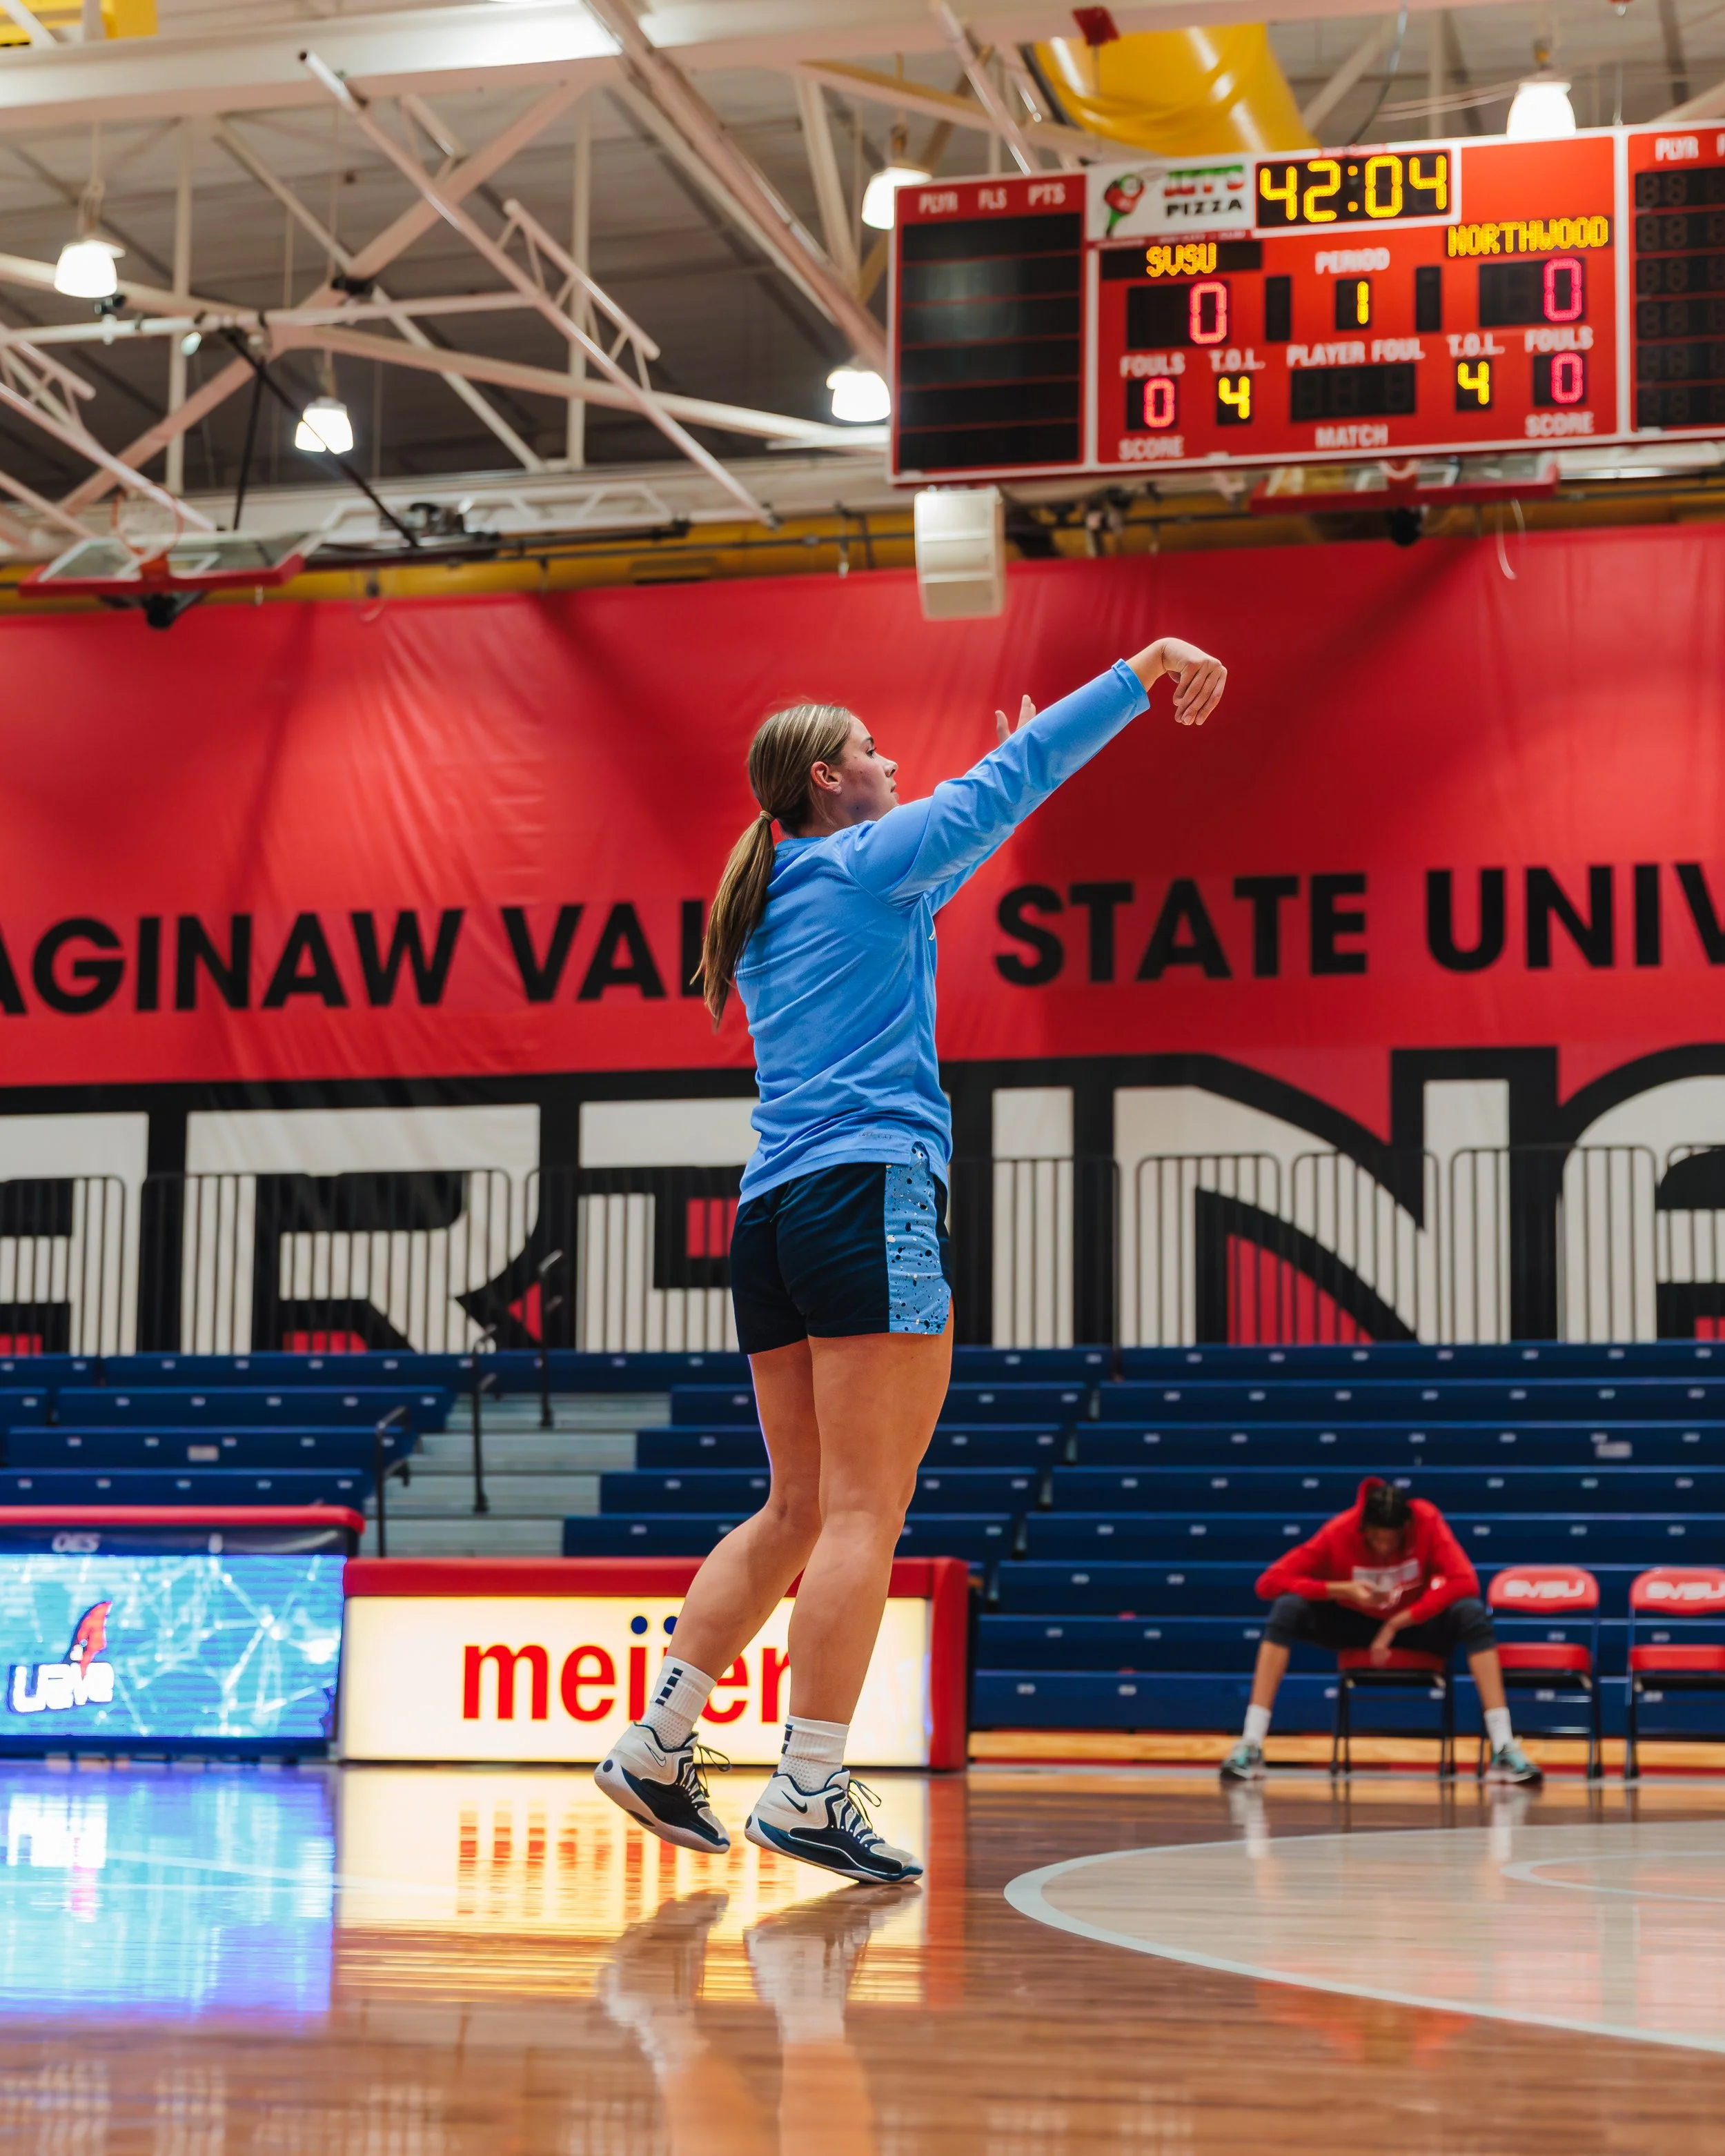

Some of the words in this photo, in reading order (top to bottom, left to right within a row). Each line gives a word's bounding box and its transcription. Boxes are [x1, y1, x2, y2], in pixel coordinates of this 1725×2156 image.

[1028, 183, 1066, 206] PTS
[1166, 198, 1242, 217] PIZZA
[1260, 155, 1447, 223] 42:04
[1448, 216, 1608, 257] NORTHWOOD
[1315, 248, 1390, 275] PERIOD
[1357, 281, 1369, 324] 1
[1544, 257, 1582, 322] 0
[1190, 281, 1227, 344] 0
[1288, 341, 1366, 368] PLAYER
[1372, 339, 1426, 362] FOUL
[1525, 327, 1594, 352] FOULS
[1121, 353, 1185, 377] FOULS
[1457, 362, 1490, 404] 4
[1550, 353, 1584, 404] 0
[1143, 377, 1174, 428] 0
[1219, 376, 1250, 419] 4
[1315, 424, 1388, 448] MATCH
[1525, 413, 1594, 437] SCORE
[1119, 436, 1185, 461] SCORE
[994, 872, 1370, 985] STATE
[462, 1616, 791, 1723] meier
